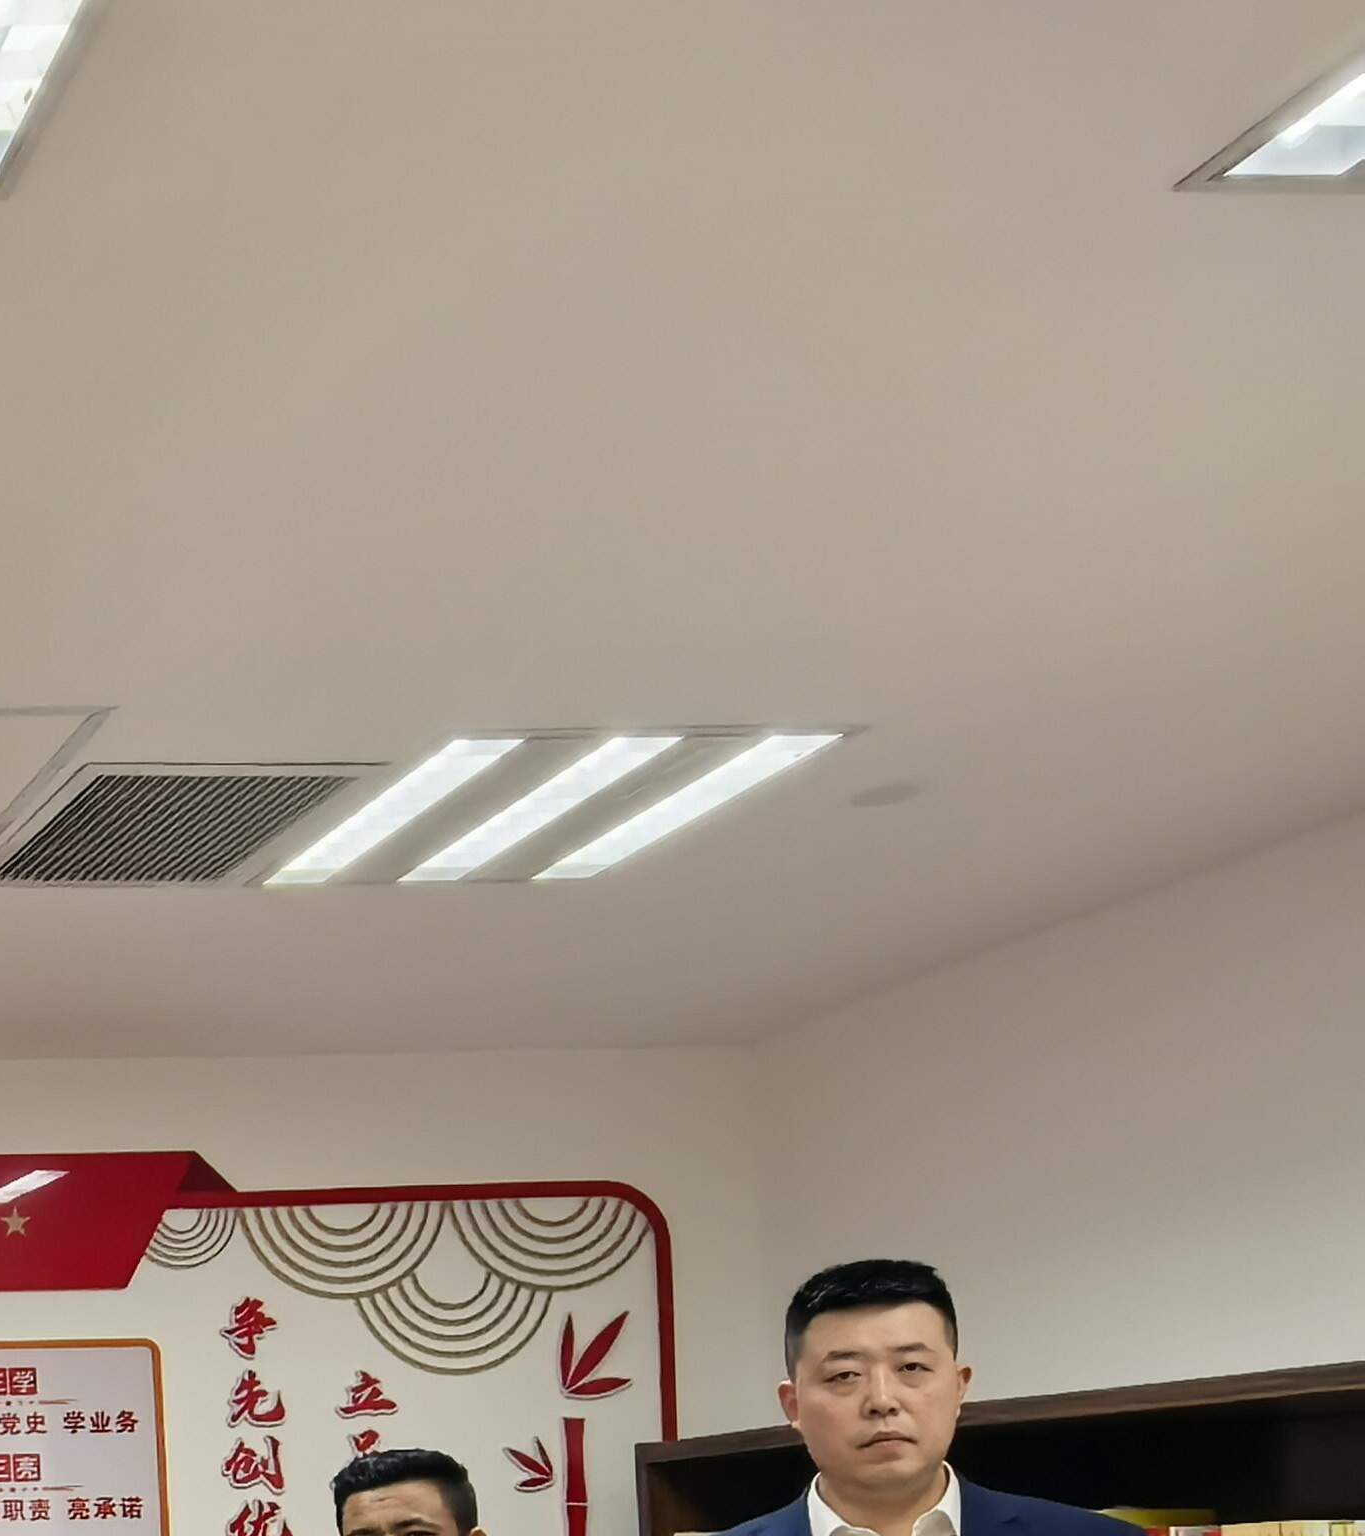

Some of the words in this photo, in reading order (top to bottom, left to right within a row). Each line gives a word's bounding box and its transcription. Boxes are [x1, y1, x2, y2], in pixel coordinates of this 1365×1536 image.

[63, 1410, 139, 1434] 学业务
[67, 1496, 144, 1520] 亮承诺
